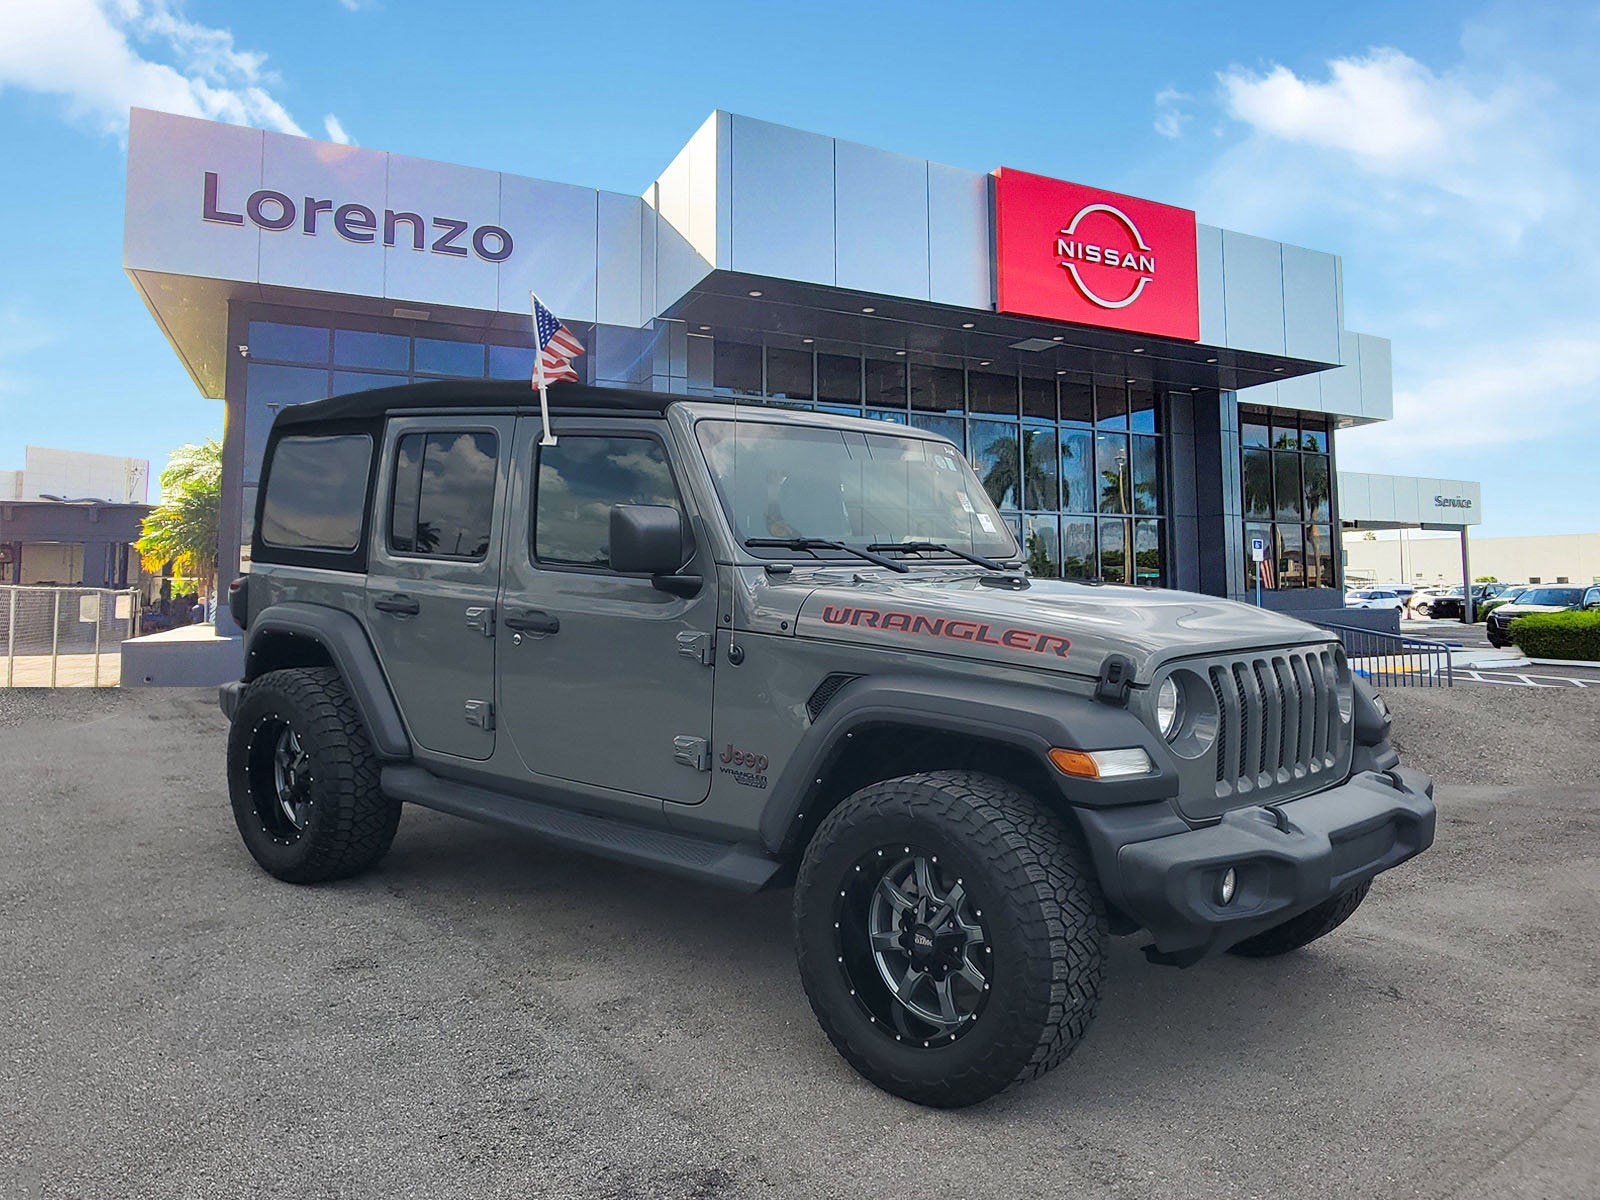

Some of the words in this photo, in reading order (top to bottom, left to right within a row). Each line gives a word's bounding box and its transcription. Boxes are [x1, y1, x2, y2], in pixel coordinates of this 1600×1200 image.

[201, 170, 515, 264] Lorenzo
[1057, 238, 1155, 274] NISSAN
[1434, 495, 1472, 509] Service
[821, 605, 1073, 659] WRANGLER
[719, 743, 769, 774] Jeep
[719, 766, 768, 782] WRANGLER
